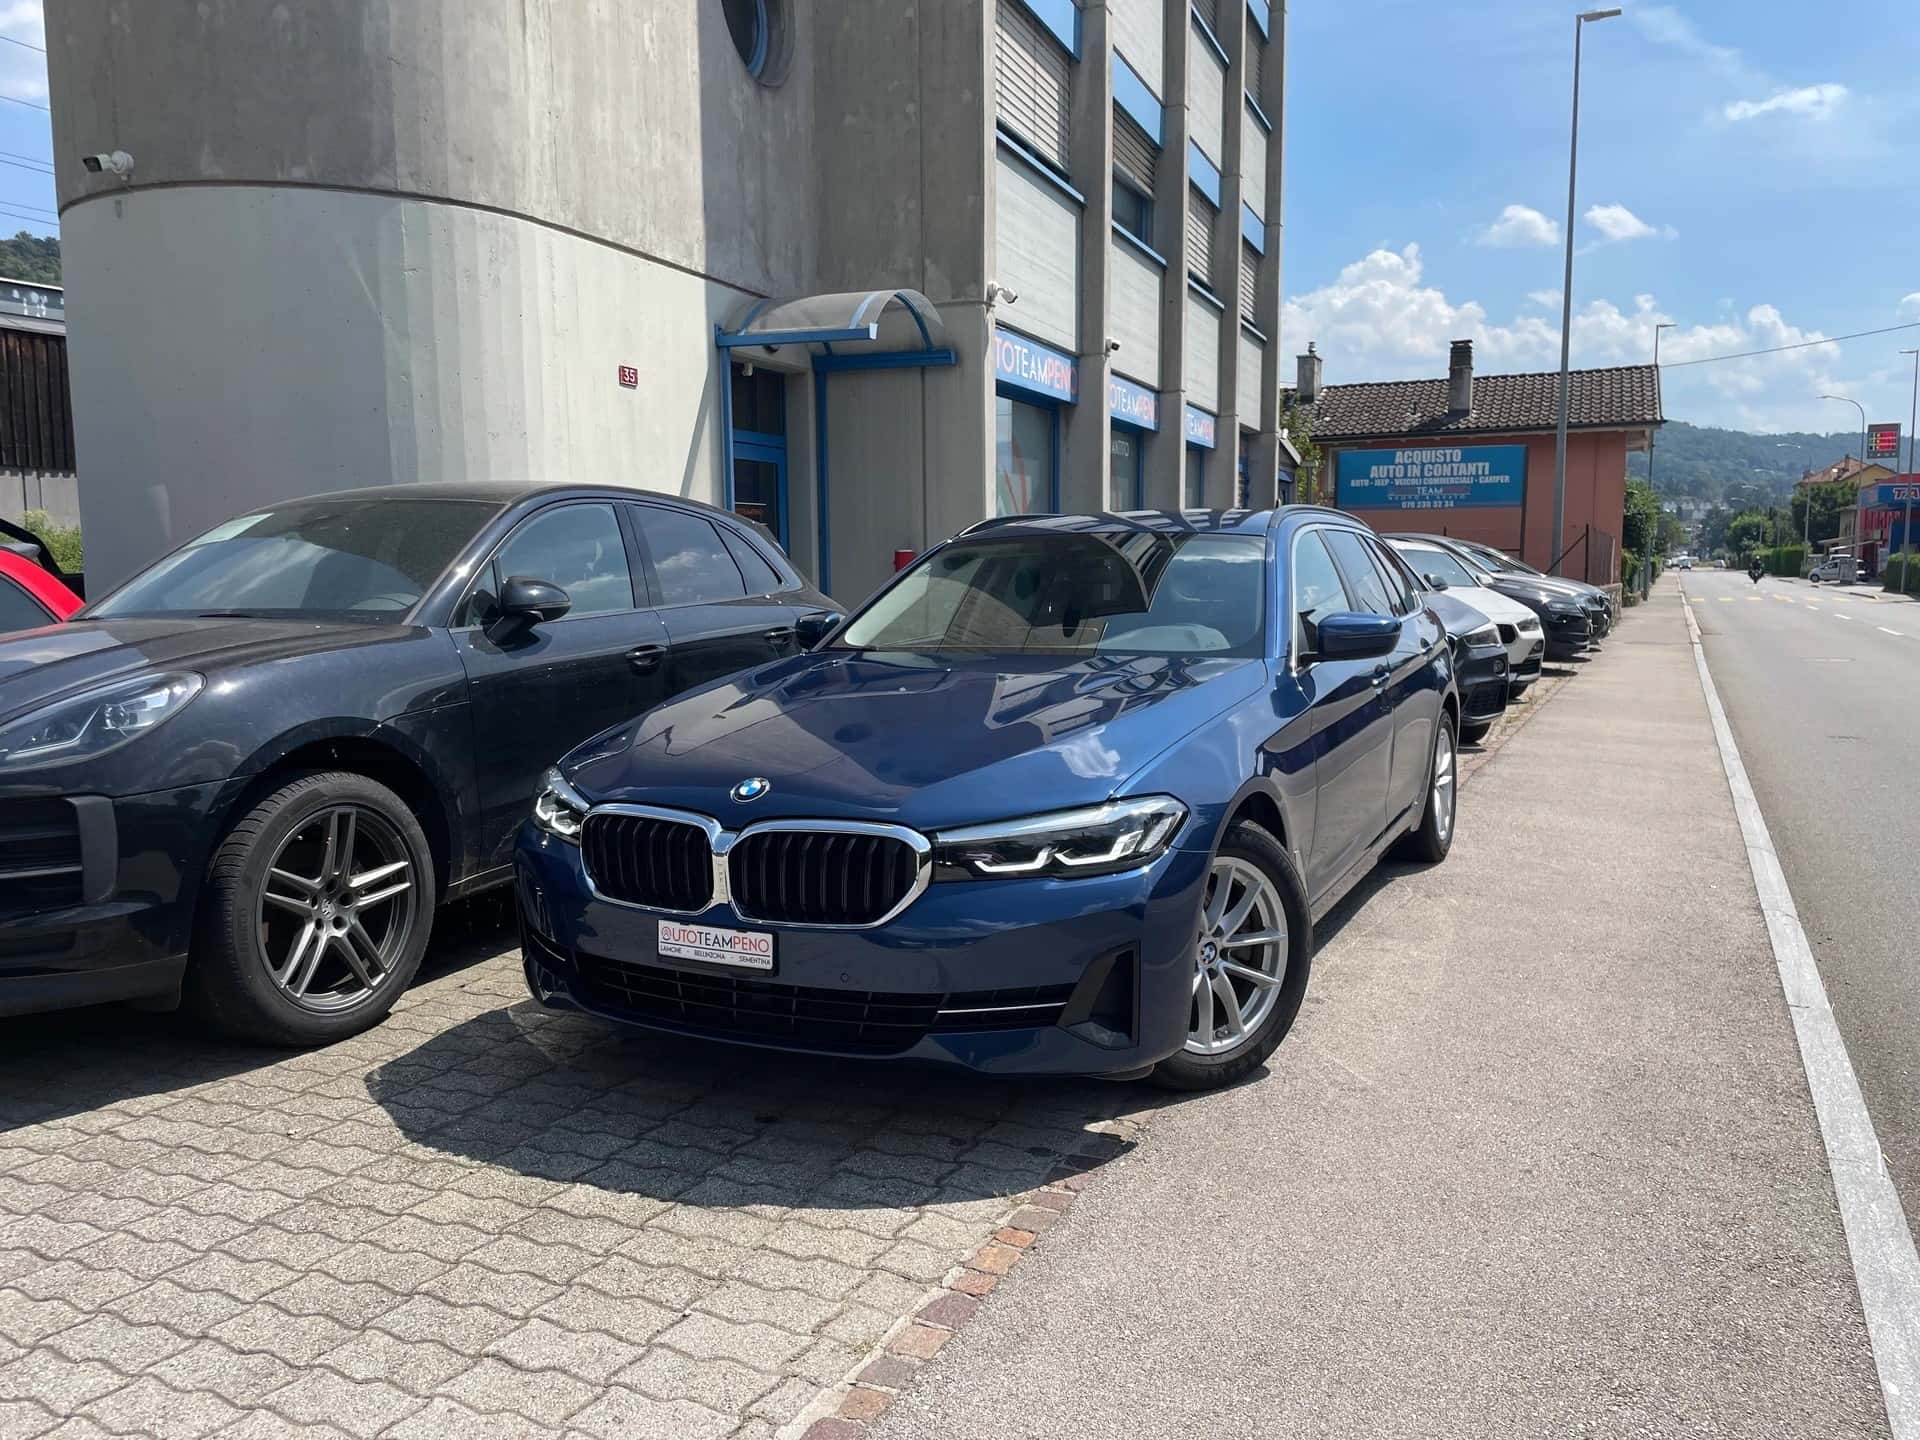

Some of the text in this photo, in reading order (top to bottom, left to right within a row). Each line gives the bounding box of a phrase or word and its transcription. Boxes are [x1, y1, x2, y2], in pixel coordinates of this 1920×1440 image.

[623, 368, 636, 382] 35
[1394, 449, 1462, 464] ACQUISTO
[1370, 462, 1490, 479] AUTO IN CONTANTI
